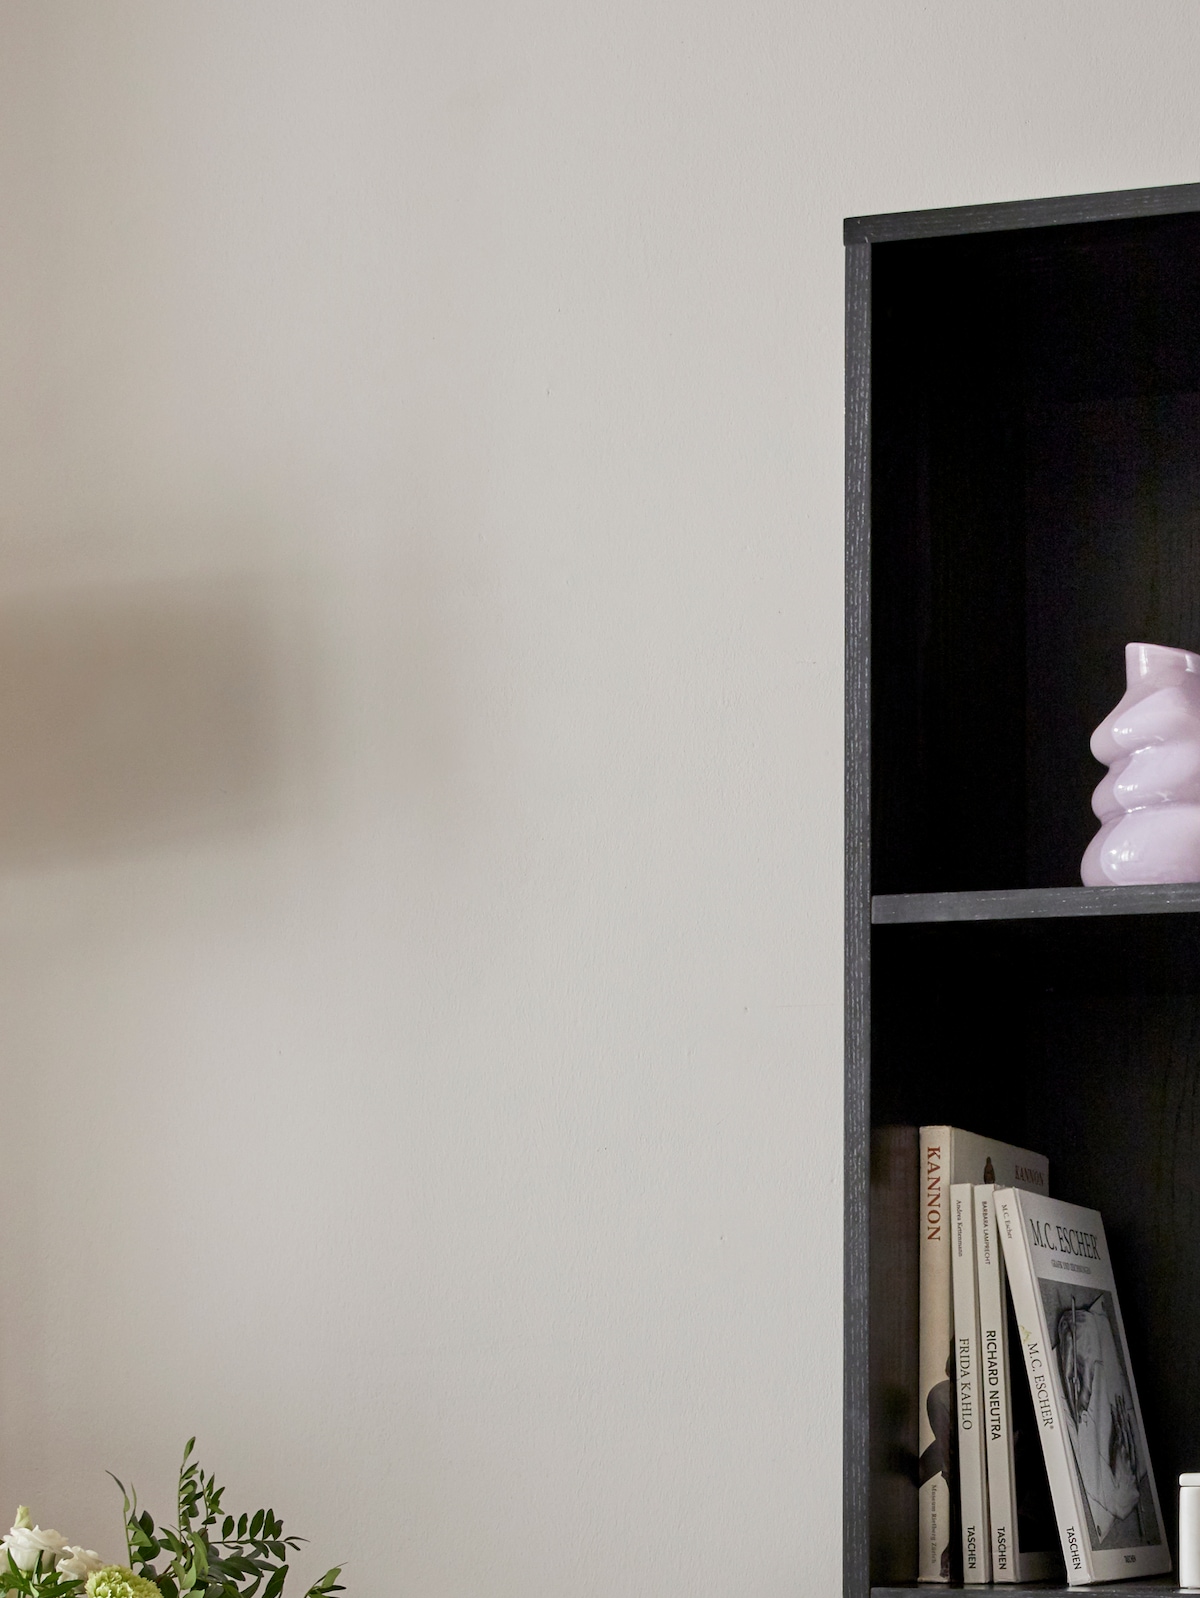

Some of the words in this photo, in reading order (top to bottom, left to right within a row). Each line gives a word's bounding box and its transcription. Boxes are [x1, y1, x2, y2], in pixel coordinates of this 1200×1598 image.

[927, 1146, 941, 1241] KANNON
[1005, 1220, 1013, 1239] Escher
[1029, 1219, 1057, 1250] M.C.
[959, 1338, 971, 1378] FRIDA
[986, 1330, 999, 1386] RICHARD
[1028, 1342, 1043, 1372] M.C.
[961, 1382, 973, 1431] KAHLO
[989, 1390, 1002, 1441] NEUTRA
[967, 1526, 977, 1569] TASCHEN
[997, 1527, 1007, 1570] TASCHEN
[1066, 1526, 1082, 1570] TASCHEN
